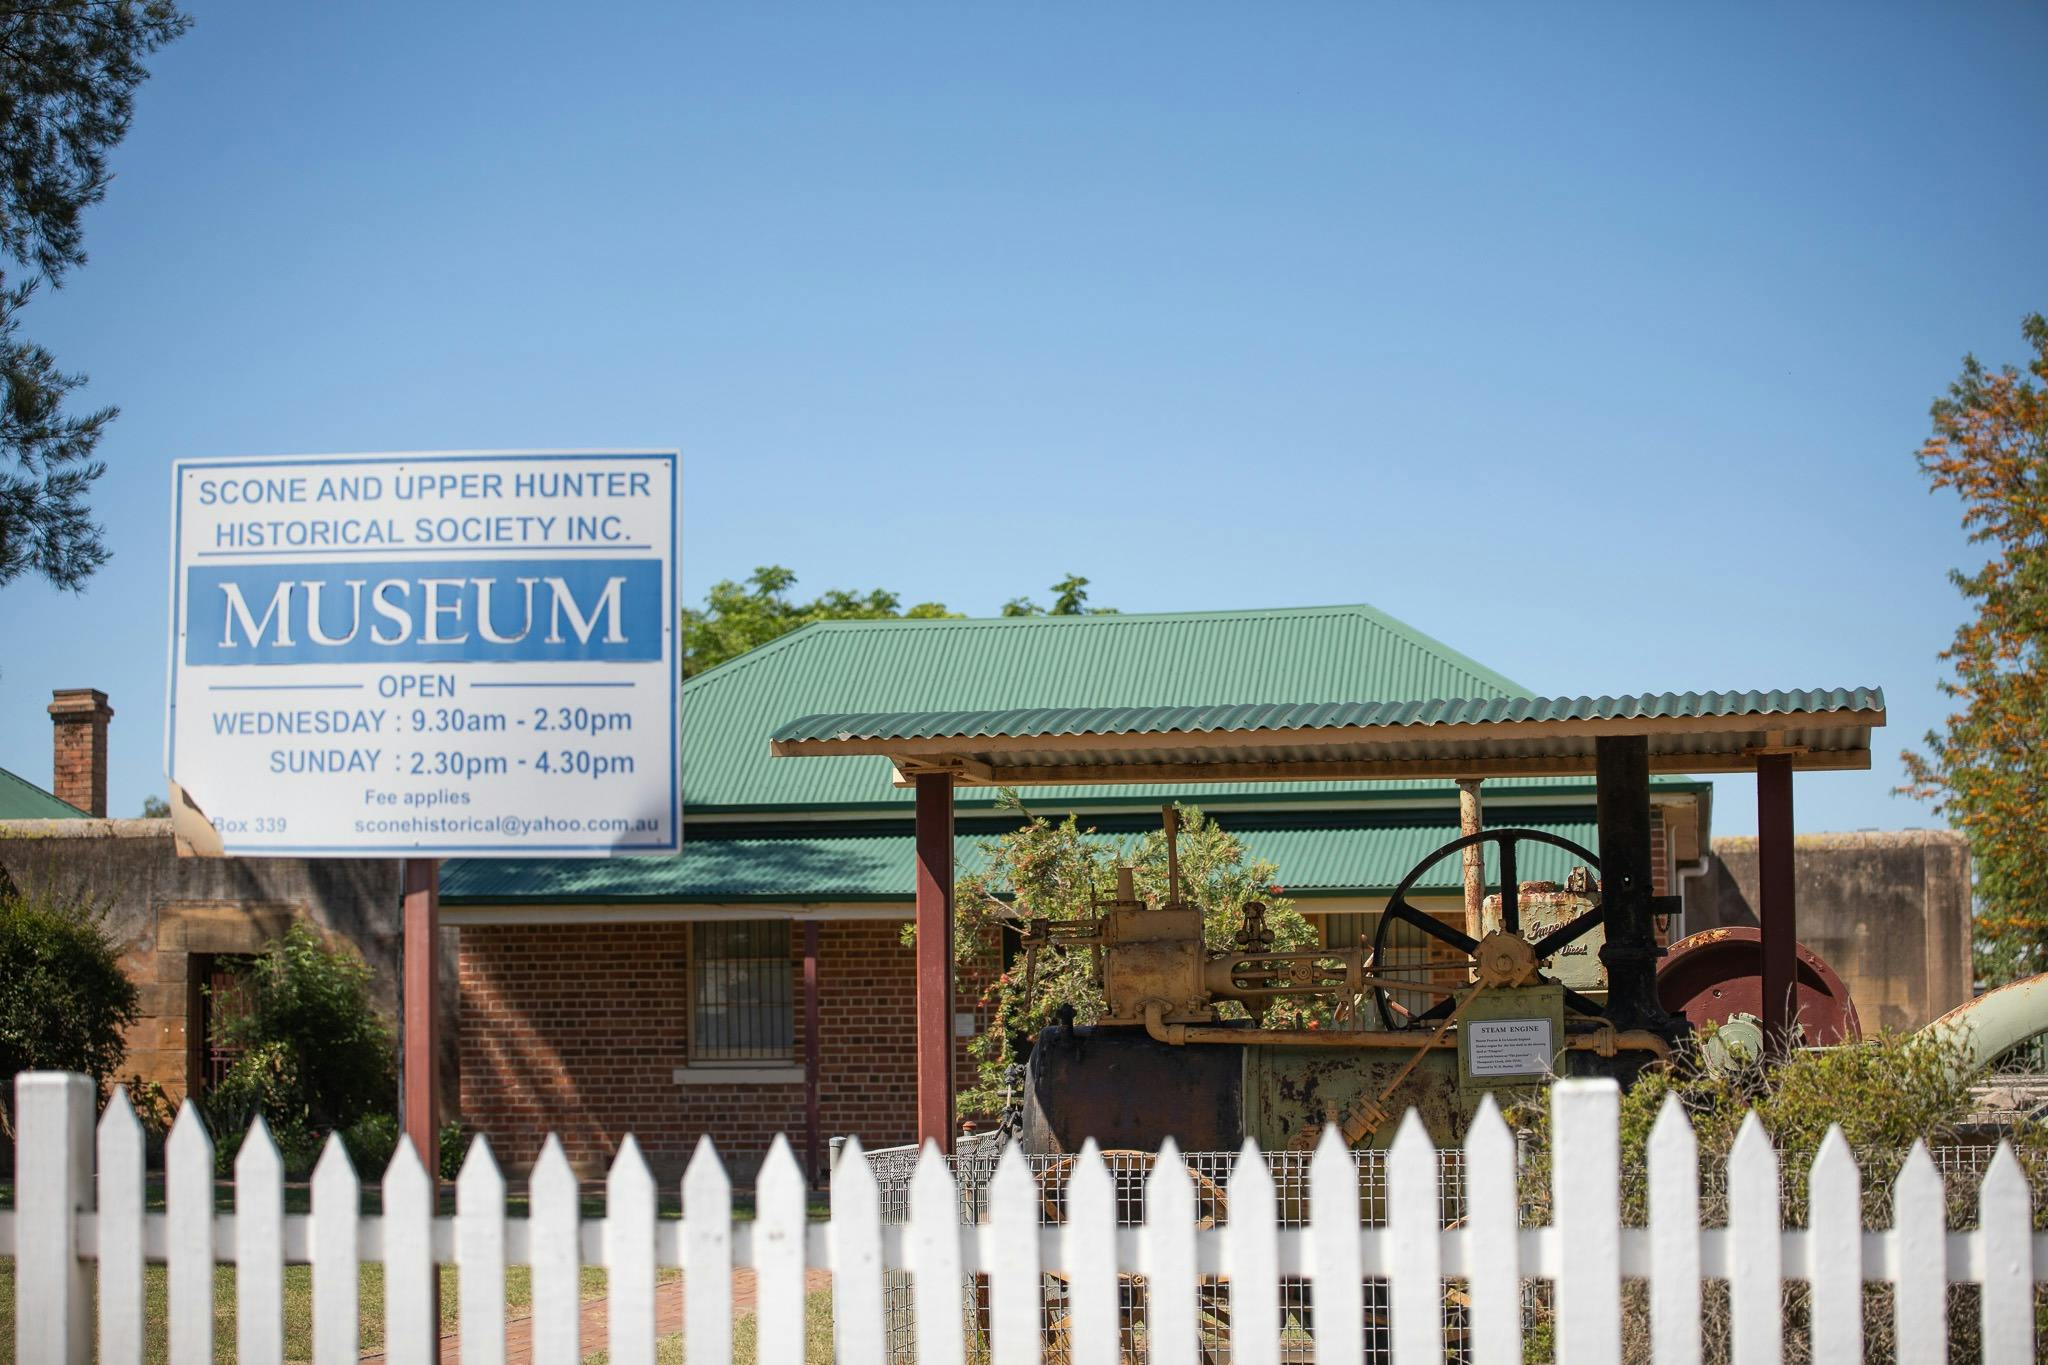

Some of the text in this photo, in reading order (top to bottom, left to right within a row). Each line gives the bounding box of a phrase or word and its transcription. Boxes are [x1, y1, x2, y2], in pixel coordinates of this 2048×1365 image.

[200, 470, 652, 505] SCONE AND UPPER HUNTER
[216, 515, 632, 547] HISTORICAL SOCIETY INC.
[218, 576, 629, 648] MUSEUM
[378, 674, 456, 698] OPEN
[213, 710, 386, 735] WEDNESDAY
[411, 707, 507, 732] 9.30am
[534, 707, 633, 737] 2.30pm
[270, 750, 381, 774] SUNDAY
[411, 751, 508, 780] 2.30pm
[535, 751, 635, 779] 4.30pm
[365, 788, 471, 808] Fee applies
[255, 816, 287, 833] 339
[354, 814, 660, 836] sconehistorical@yahoo.com.au
[1481, 1025, 1540, 1034] STEAM ENGINE
